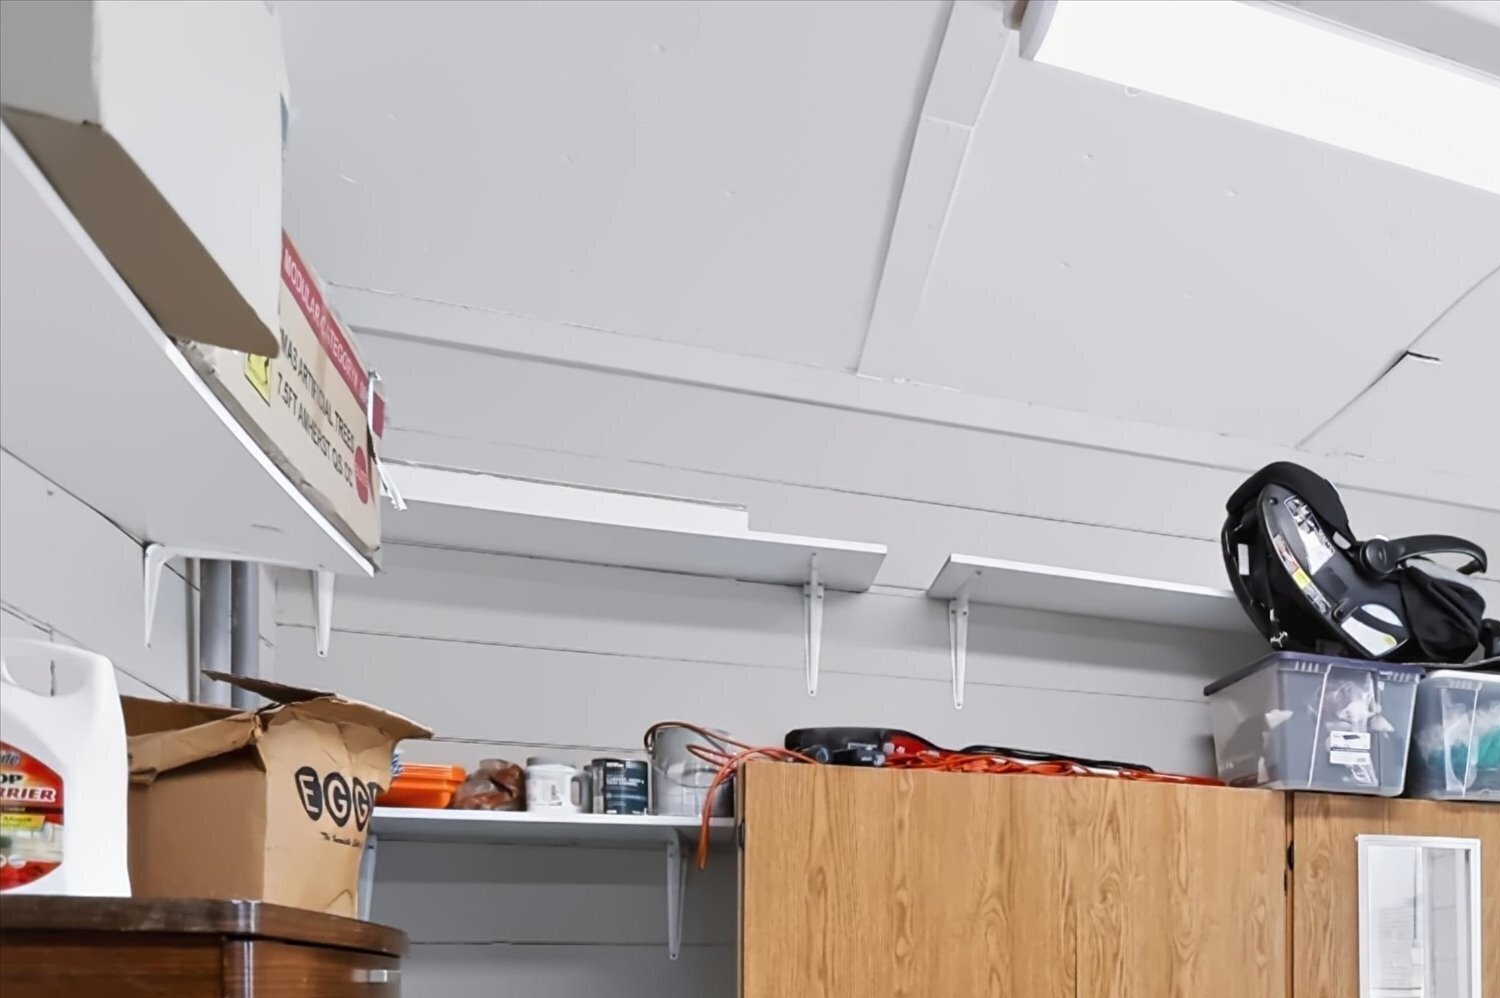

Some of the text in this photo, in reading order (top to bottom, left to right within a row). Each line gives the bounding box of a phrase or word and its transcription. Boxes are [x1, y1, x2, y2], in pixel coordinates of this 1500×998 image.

[284, 249, 320, 321] MODULAR
[277, 371, 298, 416] 7.5FT
[279, 328, 354, 454] MAS ARTIFICIAL TREES
